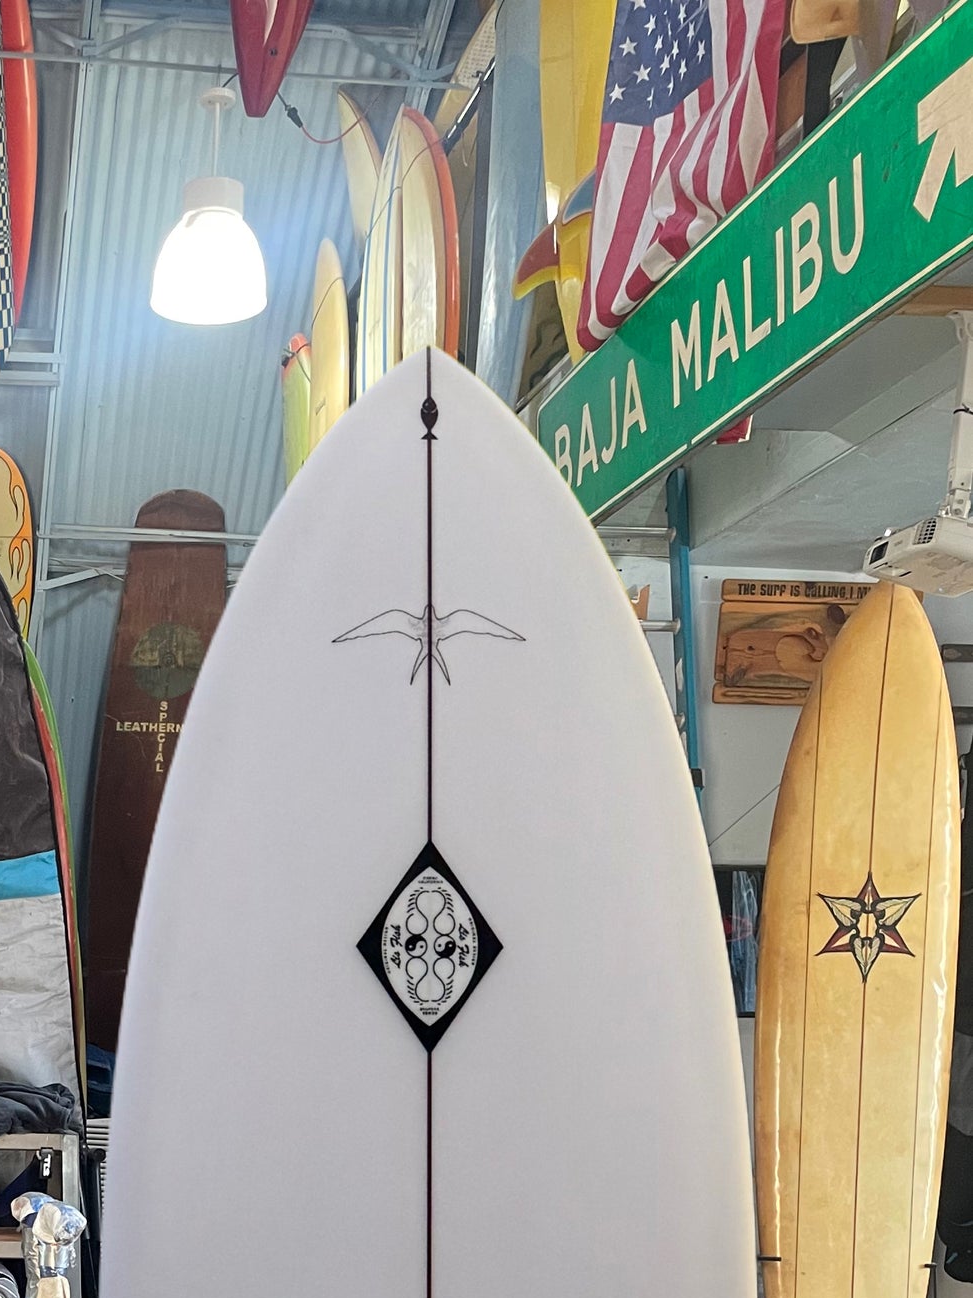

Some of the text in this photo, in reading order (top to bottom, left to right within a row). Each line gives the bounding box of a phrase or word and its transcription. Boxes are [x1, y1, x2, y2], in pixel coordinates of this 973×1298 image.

[554, 152, 865, 488] BAJA MALIBU
[790, 585, 801, 597] IS
[155, 701, 169, 772] SPECIAL
